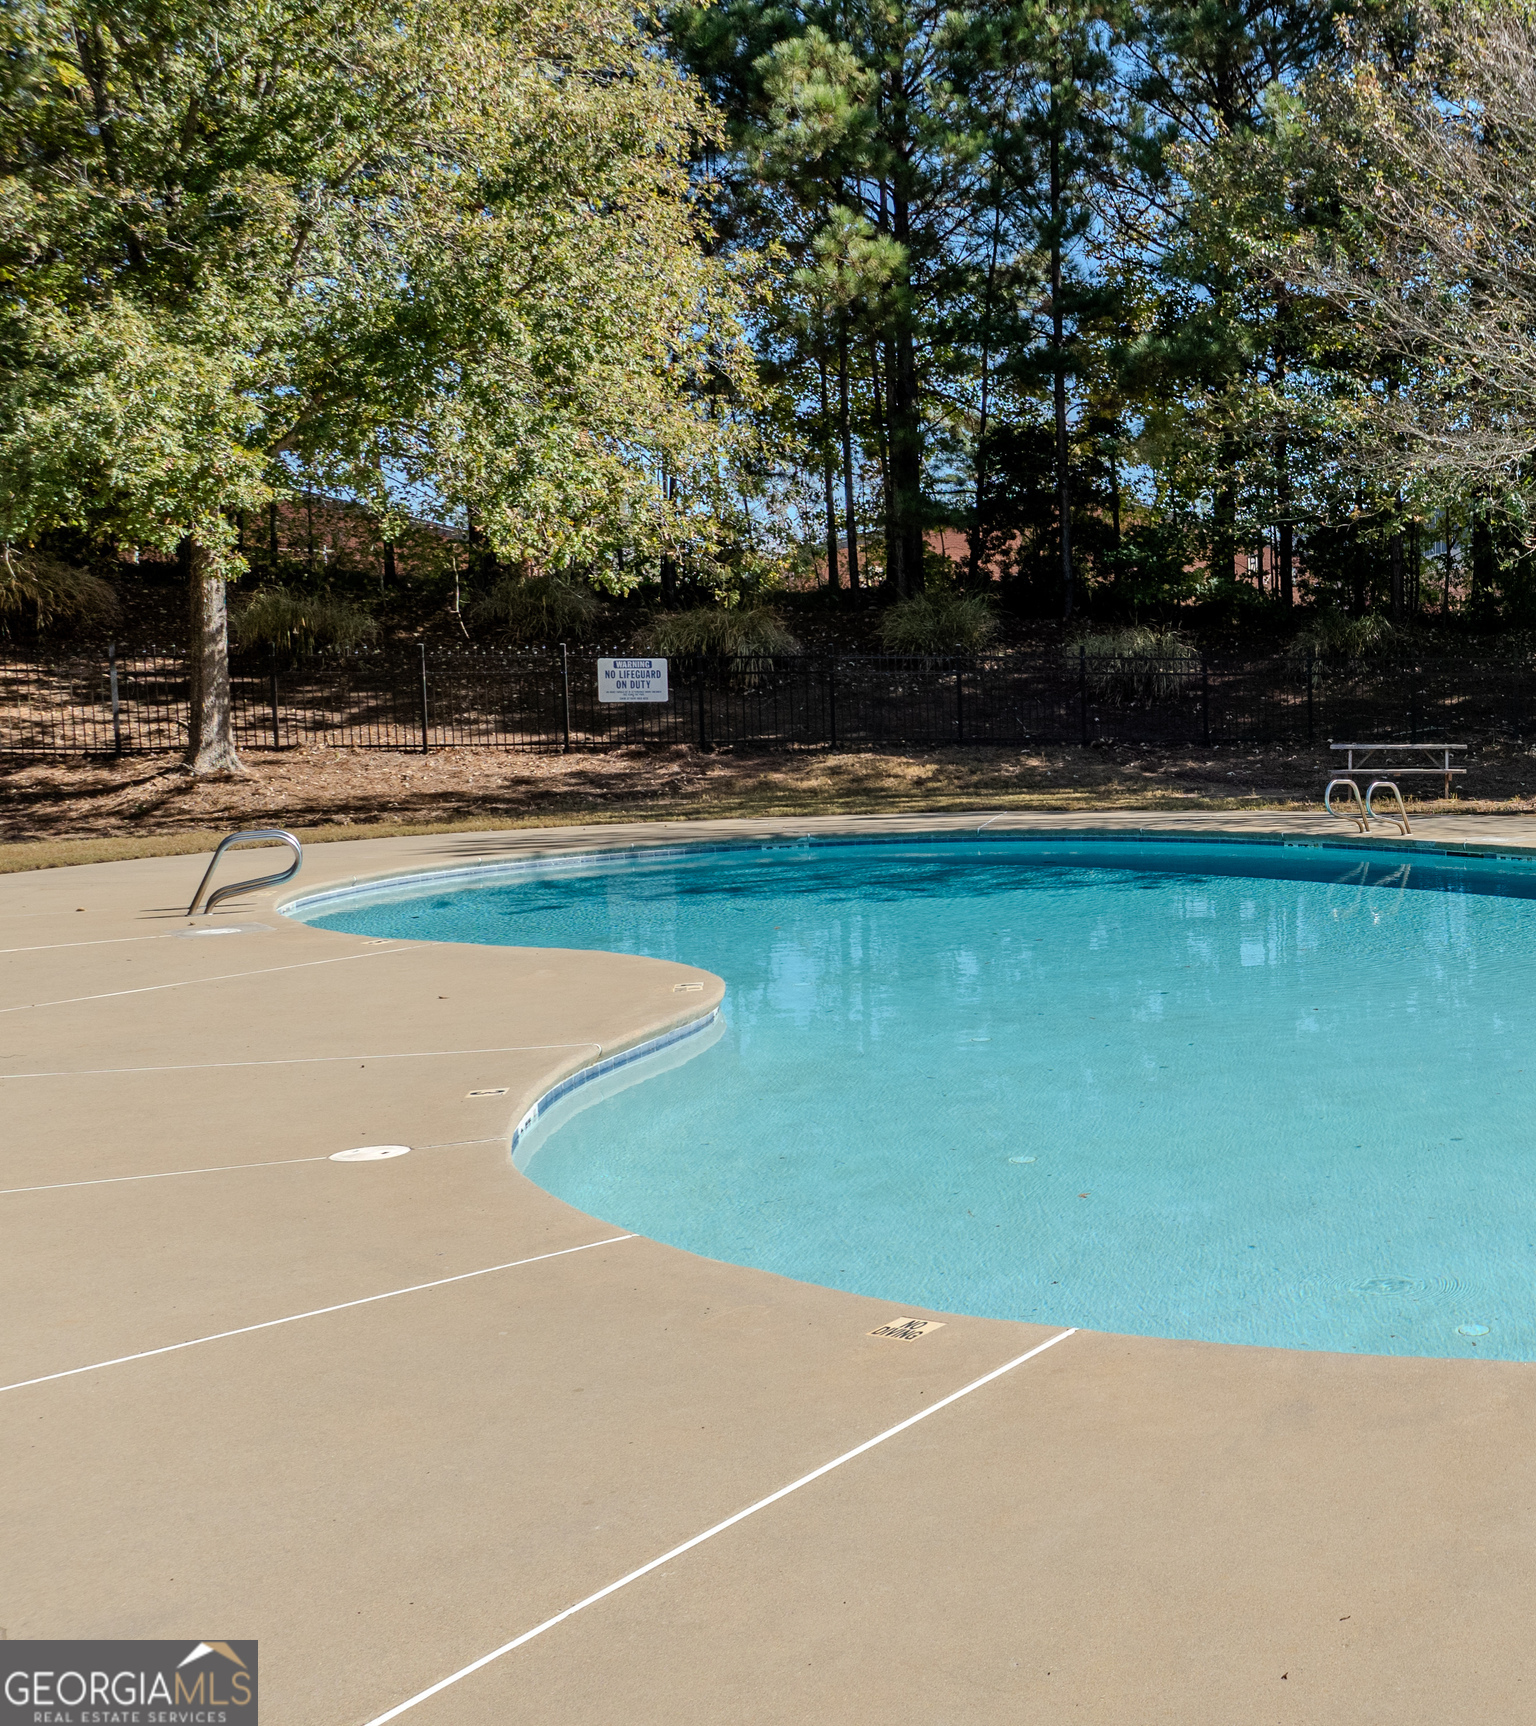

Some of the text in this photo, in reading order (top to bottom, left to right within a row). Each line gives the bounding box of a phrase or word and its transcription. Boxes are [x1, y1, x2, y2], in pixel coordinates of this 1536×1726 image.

[615, 660, 650, 668] WARNING
[605, 670, 662, 679] NO LIFEGUARD
[616, 680, 651, 689] ON DUTY
[899, 1319, 928, 1330] NO
[870, 1326, 923, 1340] DIVING
